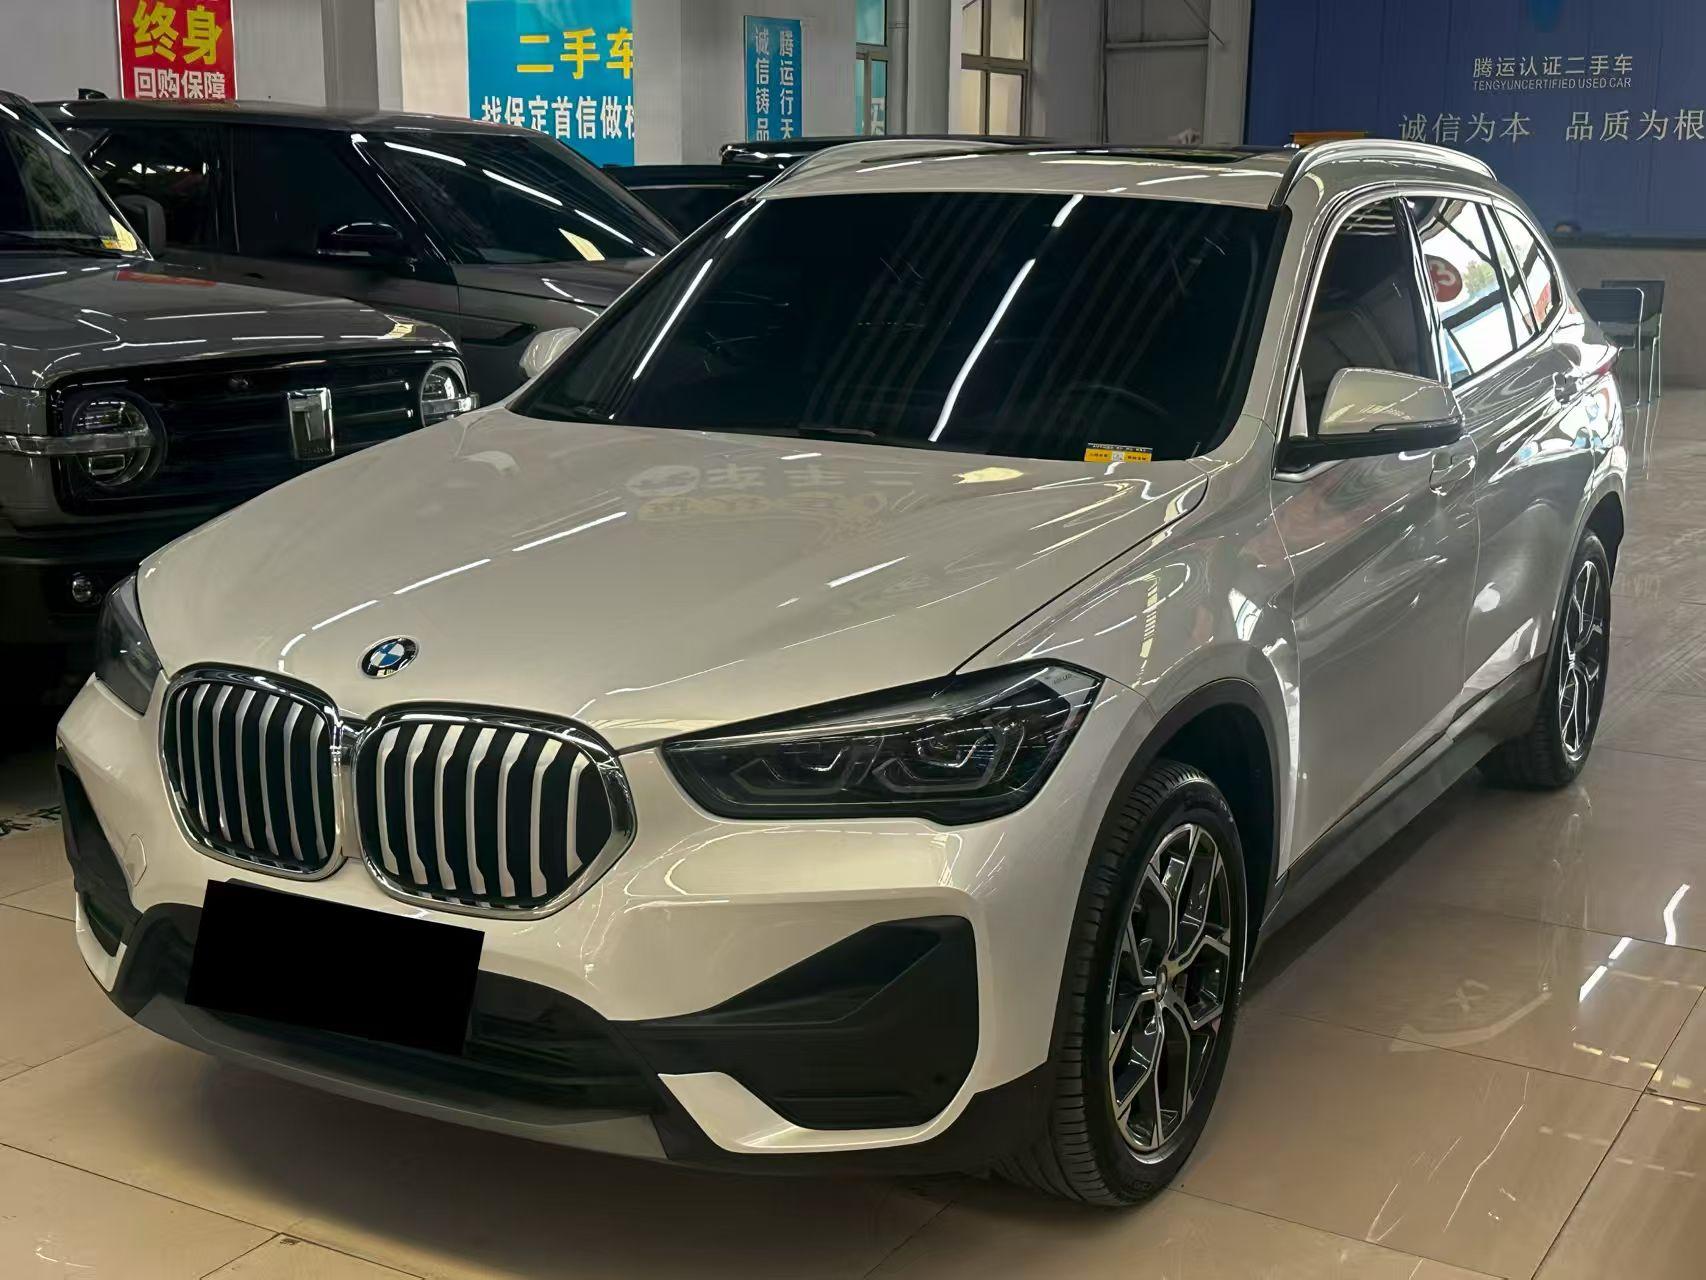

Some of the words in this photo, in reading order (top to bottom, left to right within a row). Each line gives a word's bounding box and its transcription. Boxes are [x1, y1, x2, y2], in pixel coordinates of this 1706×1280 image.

[133, 1, 223, 65] 终身
[517, 27, 634, 80] 二手车
[1473, 54, 1633, 78] 腾运认证二手车
[134, 67, 226, 99] 回购保障
[780, 30, 794, 140] 腾运行天
[1578, 78, 1607, 89] USED
[1609, 78, 1632, 88] CAR
[1399, 111, 1531, 143] 诚信为本
[1566, 109, 1705, 142] 品质为根
